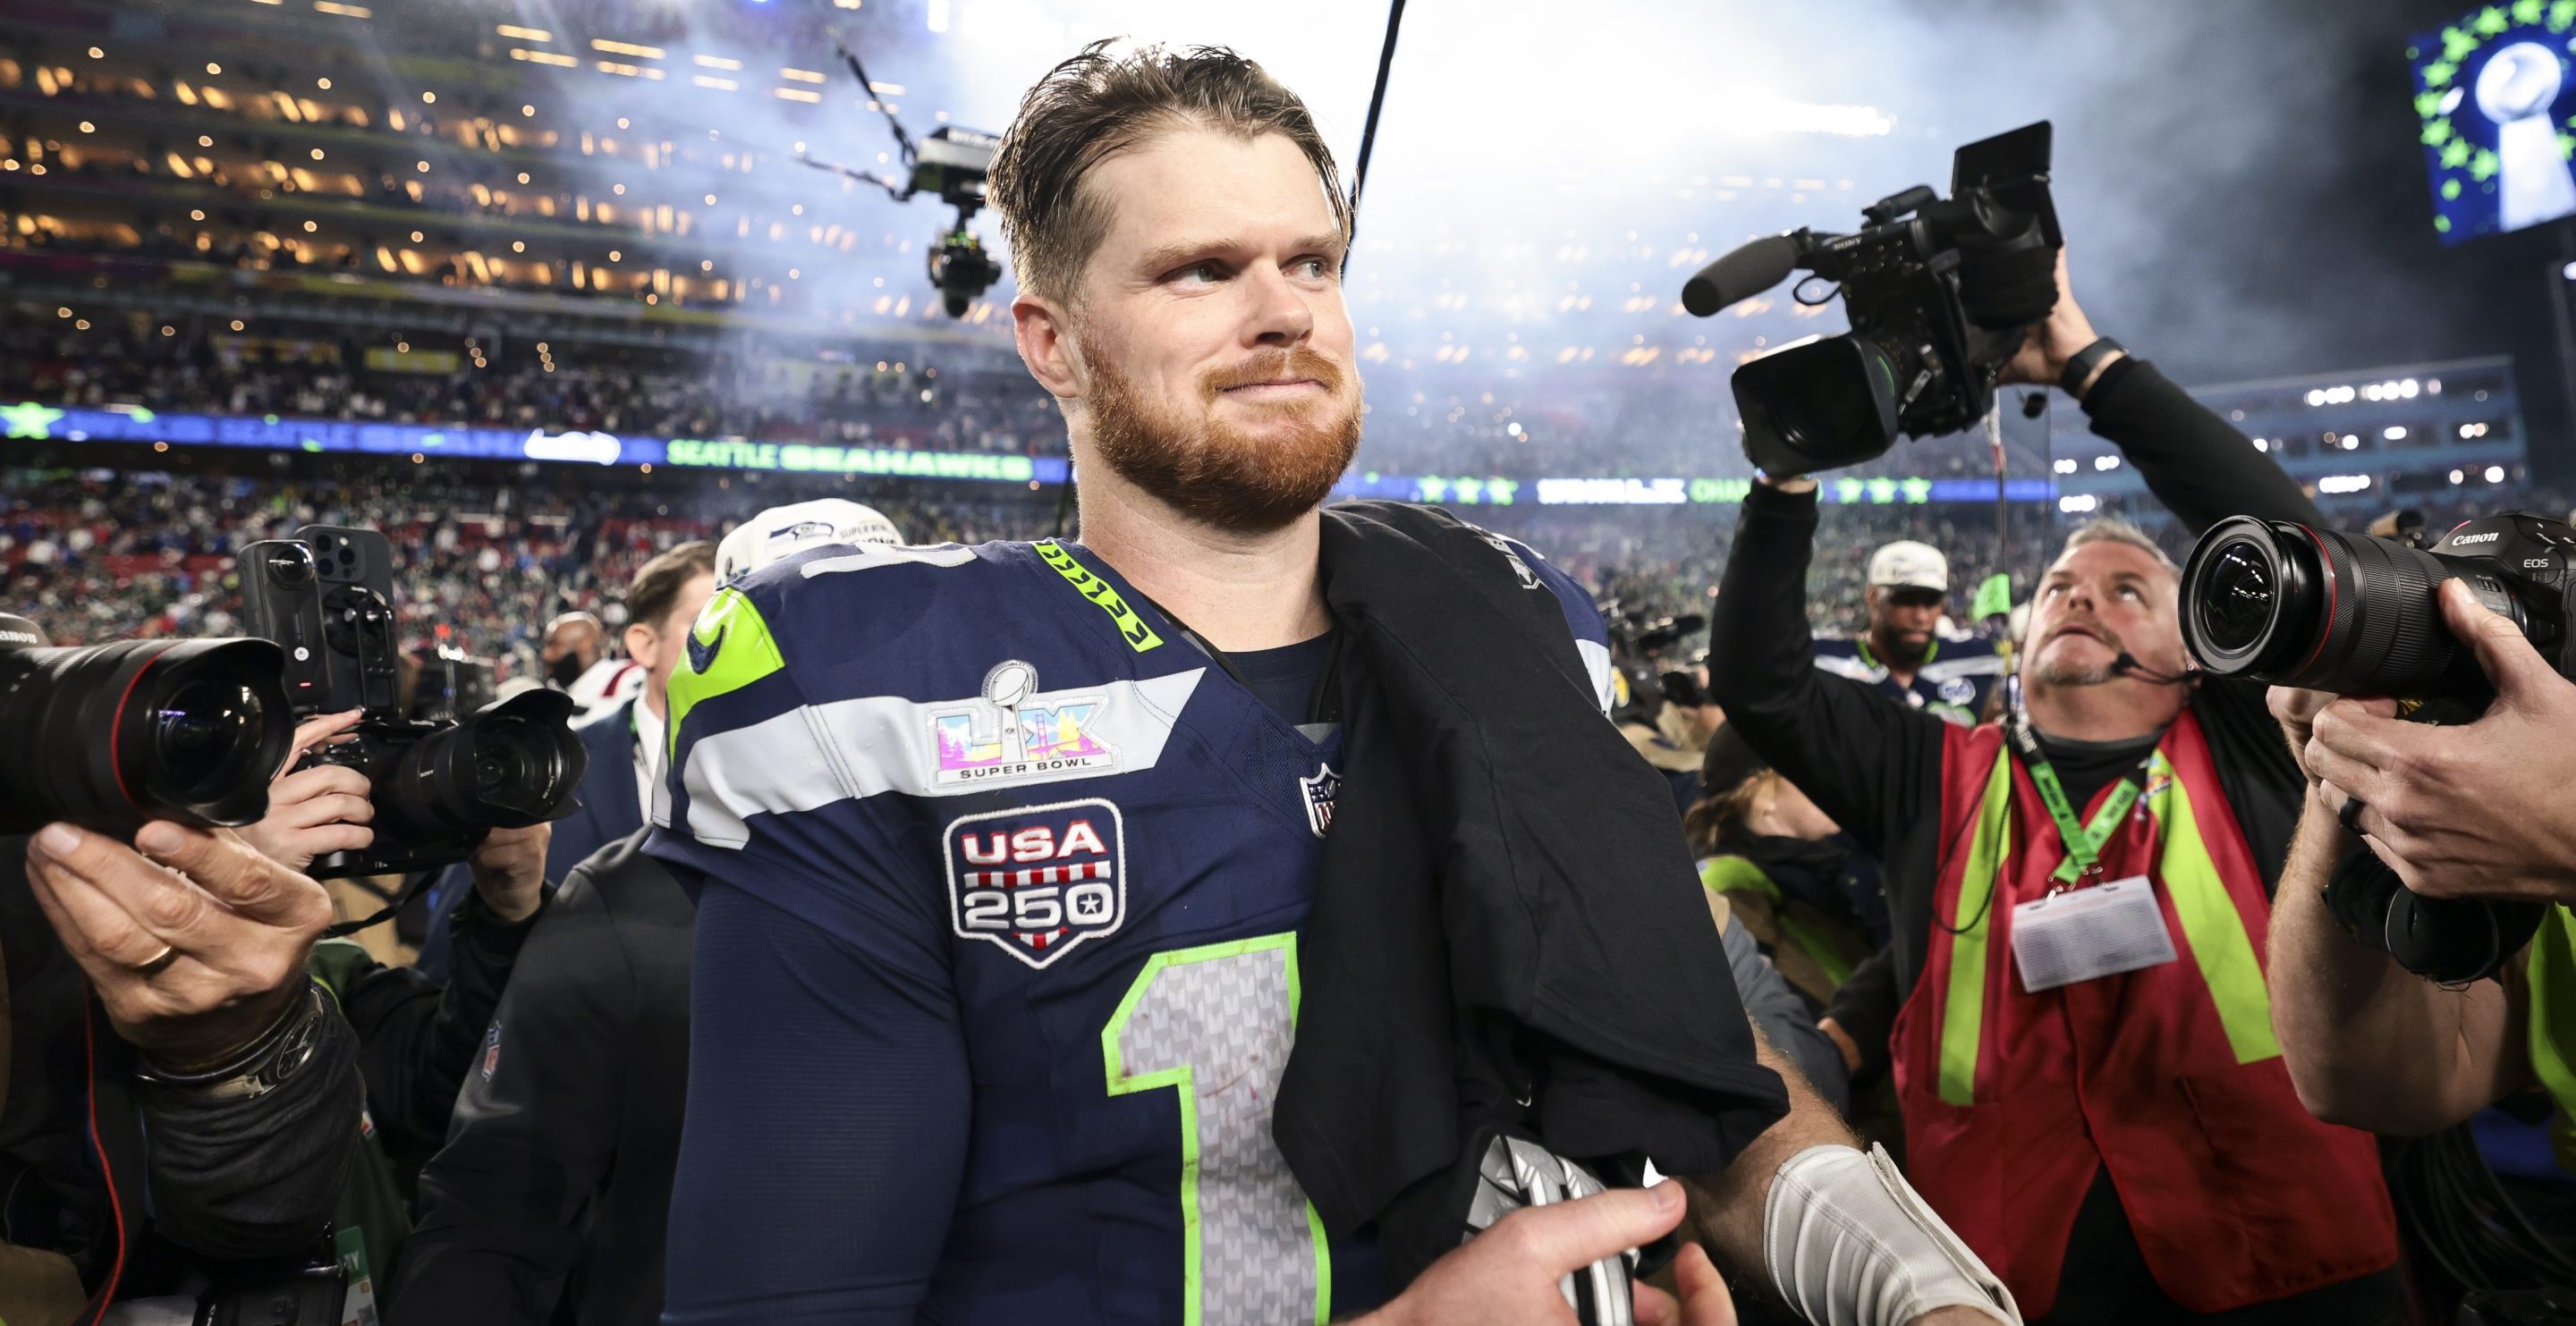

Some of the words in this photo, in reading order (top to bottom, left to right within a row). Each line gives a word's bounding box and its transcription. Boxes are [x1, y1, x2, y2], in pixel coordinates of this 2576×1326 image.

[667, 439, 778, 469] SEATTLE
[779, 444, 1034, 481] SEAHAWKS
[2452, 532, 2499, 546] Canon
[2523, 558, 2549, 568] EOS
[0, 630, 38, 644] anon
[960, 764, 1027, 780] SUPER
[1037, 757, 1092, 772] BOWL
[961, 818, 1108, 866] USA
[963, 882, 1114, 930] 250
